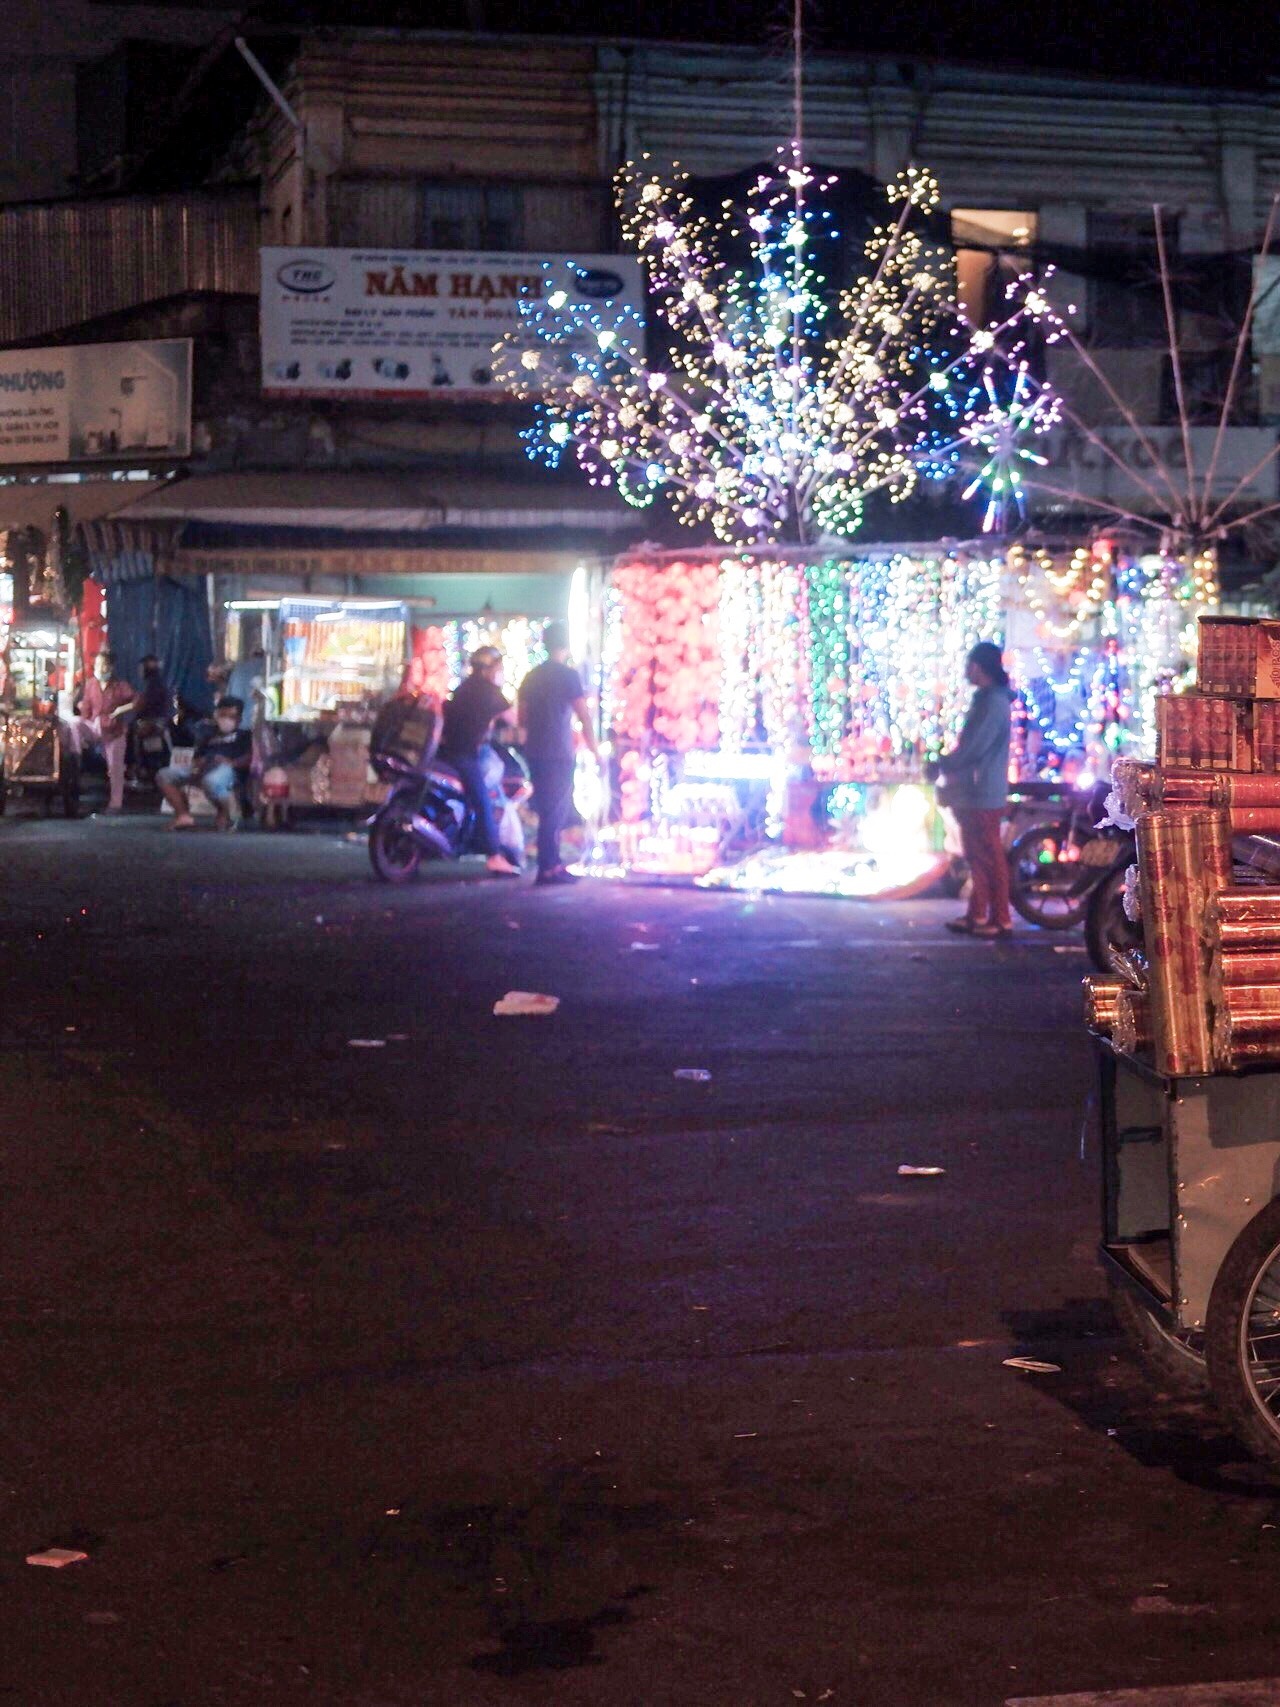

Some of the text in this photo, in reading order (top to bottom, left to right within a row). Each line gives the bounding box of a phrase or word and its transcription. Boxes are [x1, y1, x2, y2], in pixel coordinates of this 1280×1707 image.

[365, 265, 439, 298] NĂM
[449, 272, 544, 305] HẠNH
[0, 368, 65, 396] HƯỢNG
